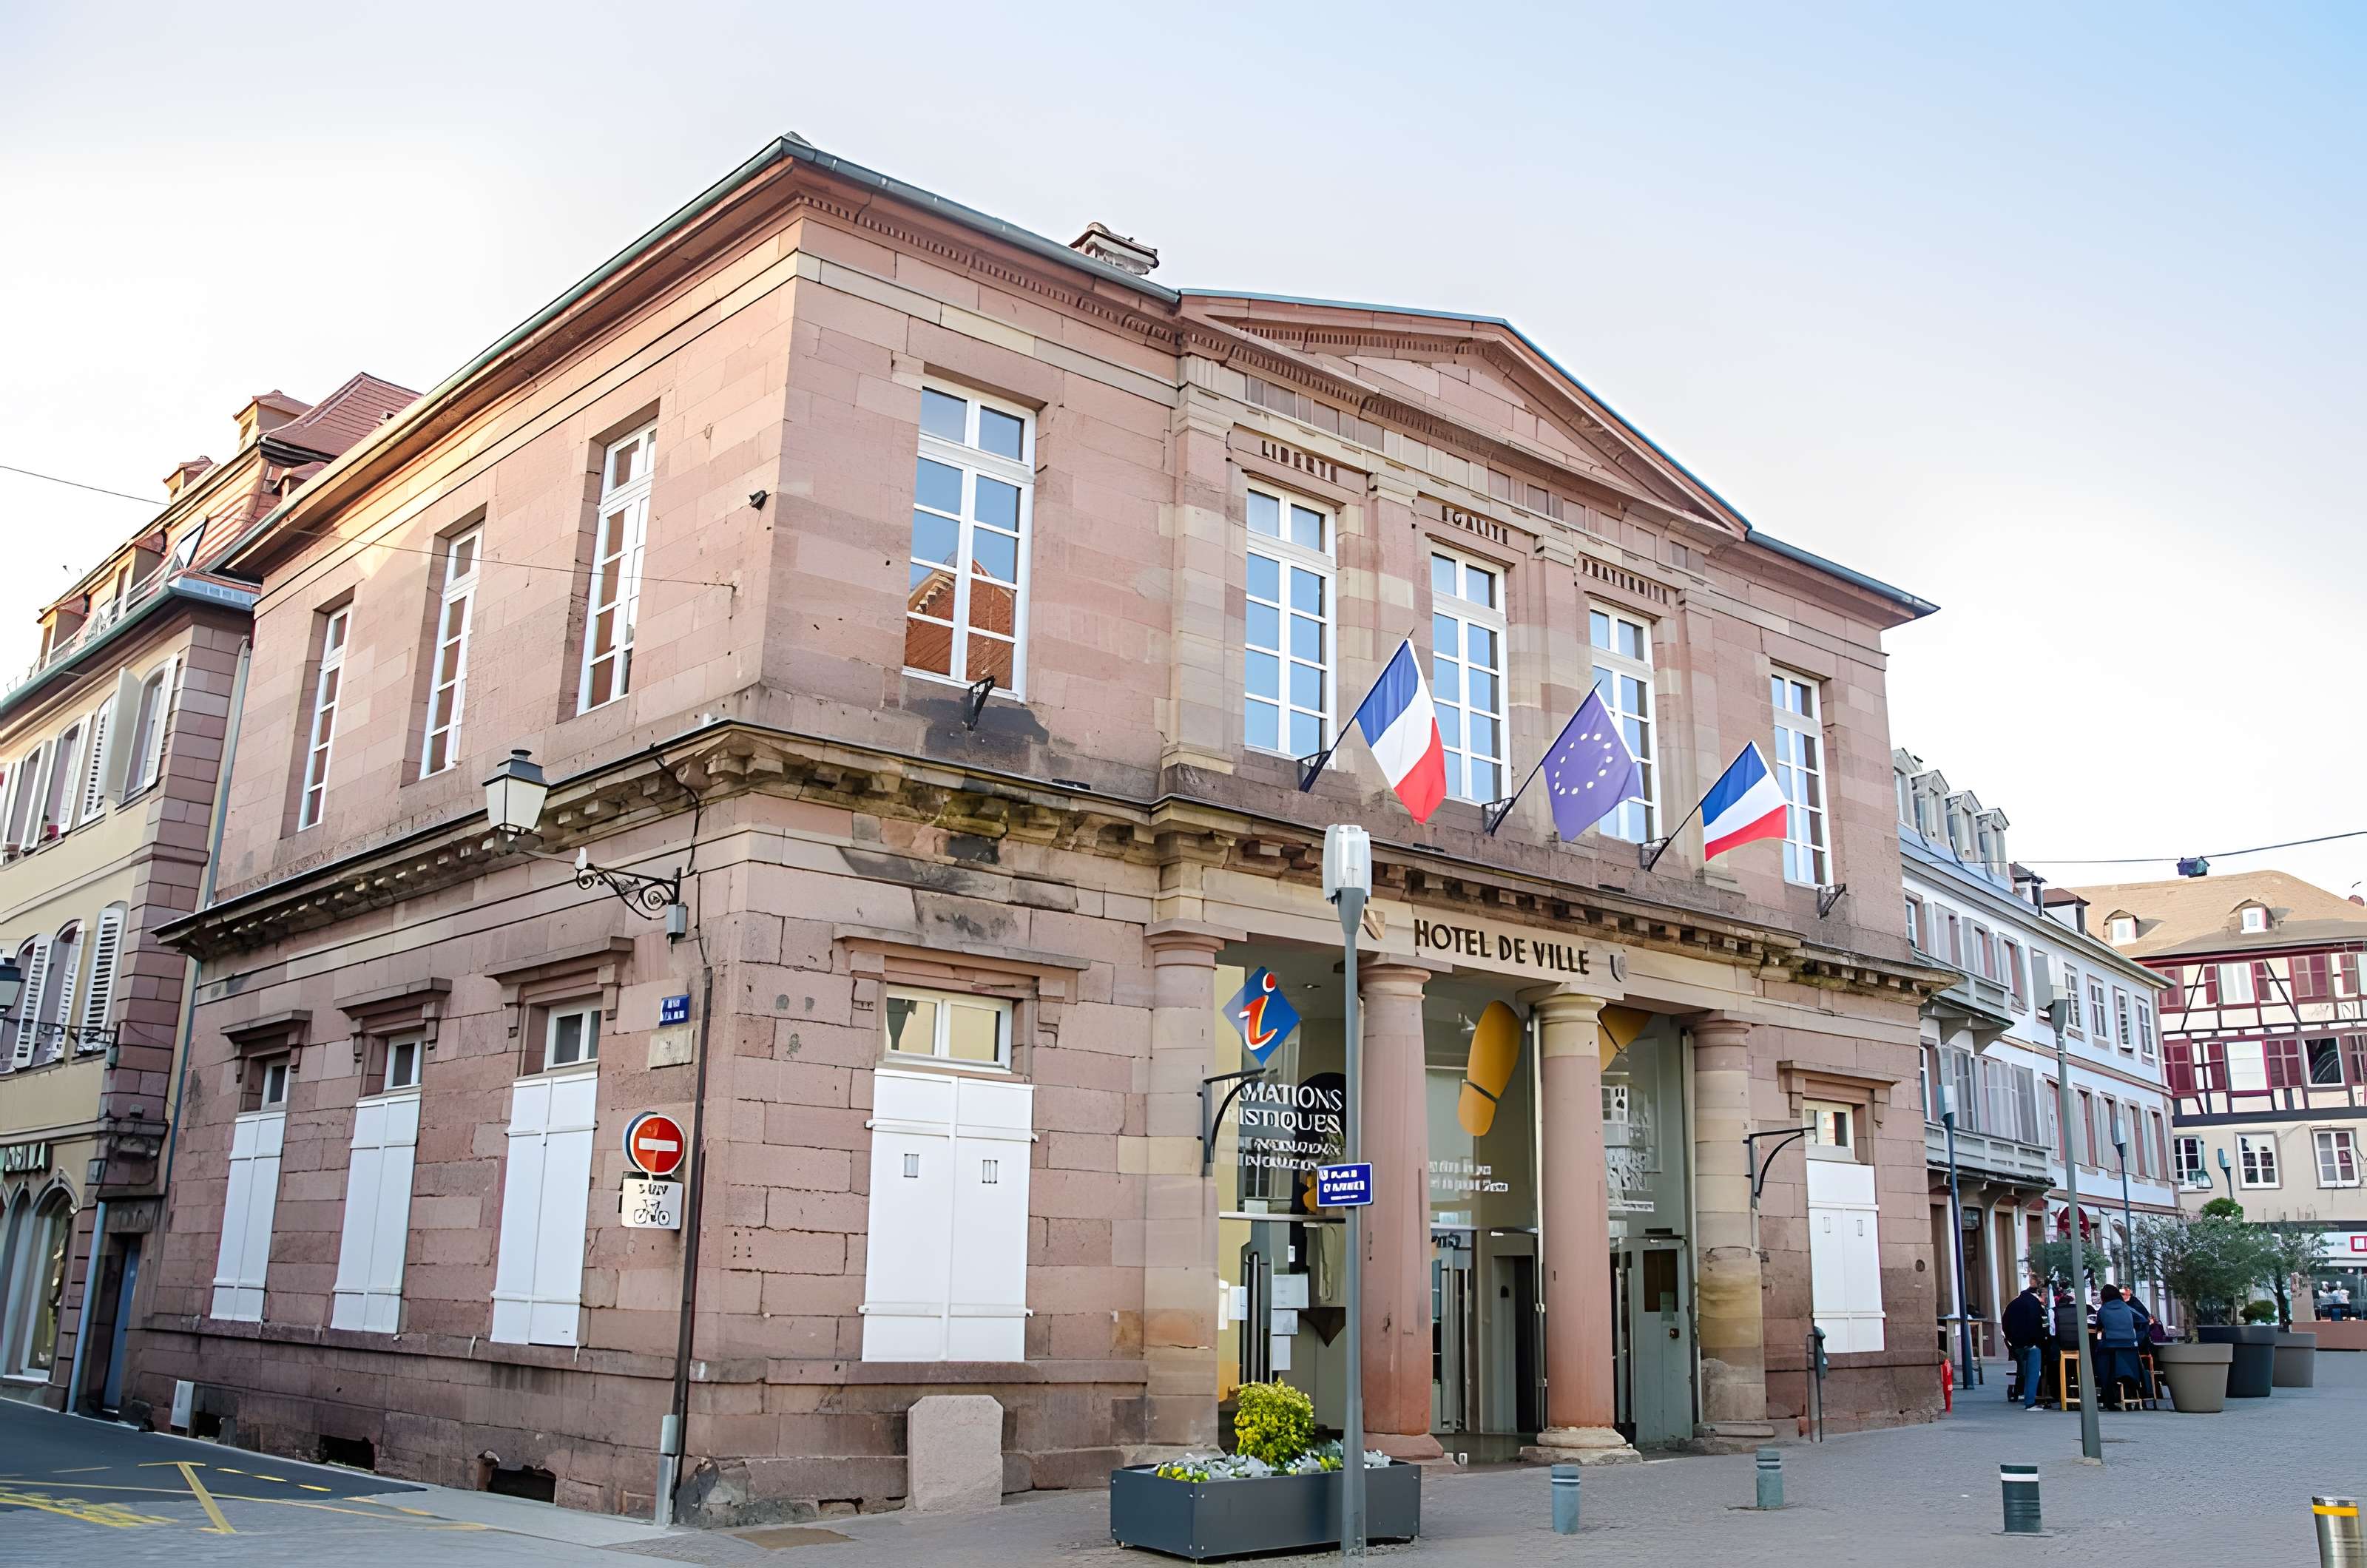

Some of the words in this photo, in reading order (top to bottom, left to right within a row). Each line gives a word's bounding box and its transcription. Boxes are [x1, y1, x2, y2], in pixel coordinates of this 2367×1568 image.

[1414, 919, 1492, 959] HOTEL
[1498, 934, 1527, 964] DE
[1532, 940, 1590, 976] VILLE
